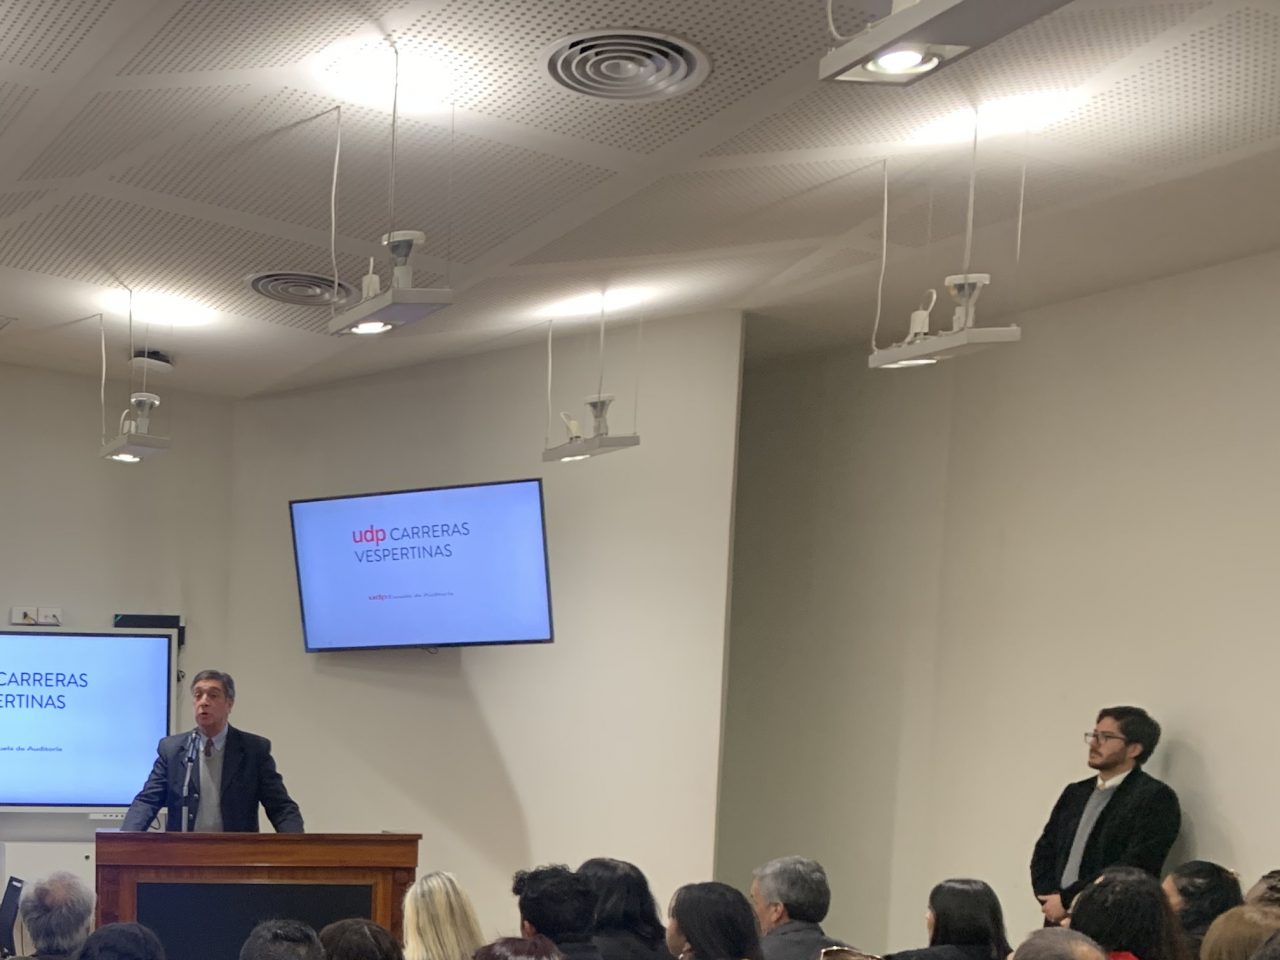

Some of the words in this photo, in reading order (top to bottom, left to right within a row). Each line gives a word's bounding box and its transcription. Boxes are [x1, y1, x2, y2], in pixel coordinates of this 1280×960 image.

[350, 525, 387, 546] udp
[389, 522, 470, 541] CARRERAS
[354, 544, 453, 563] VESPERTINAS
